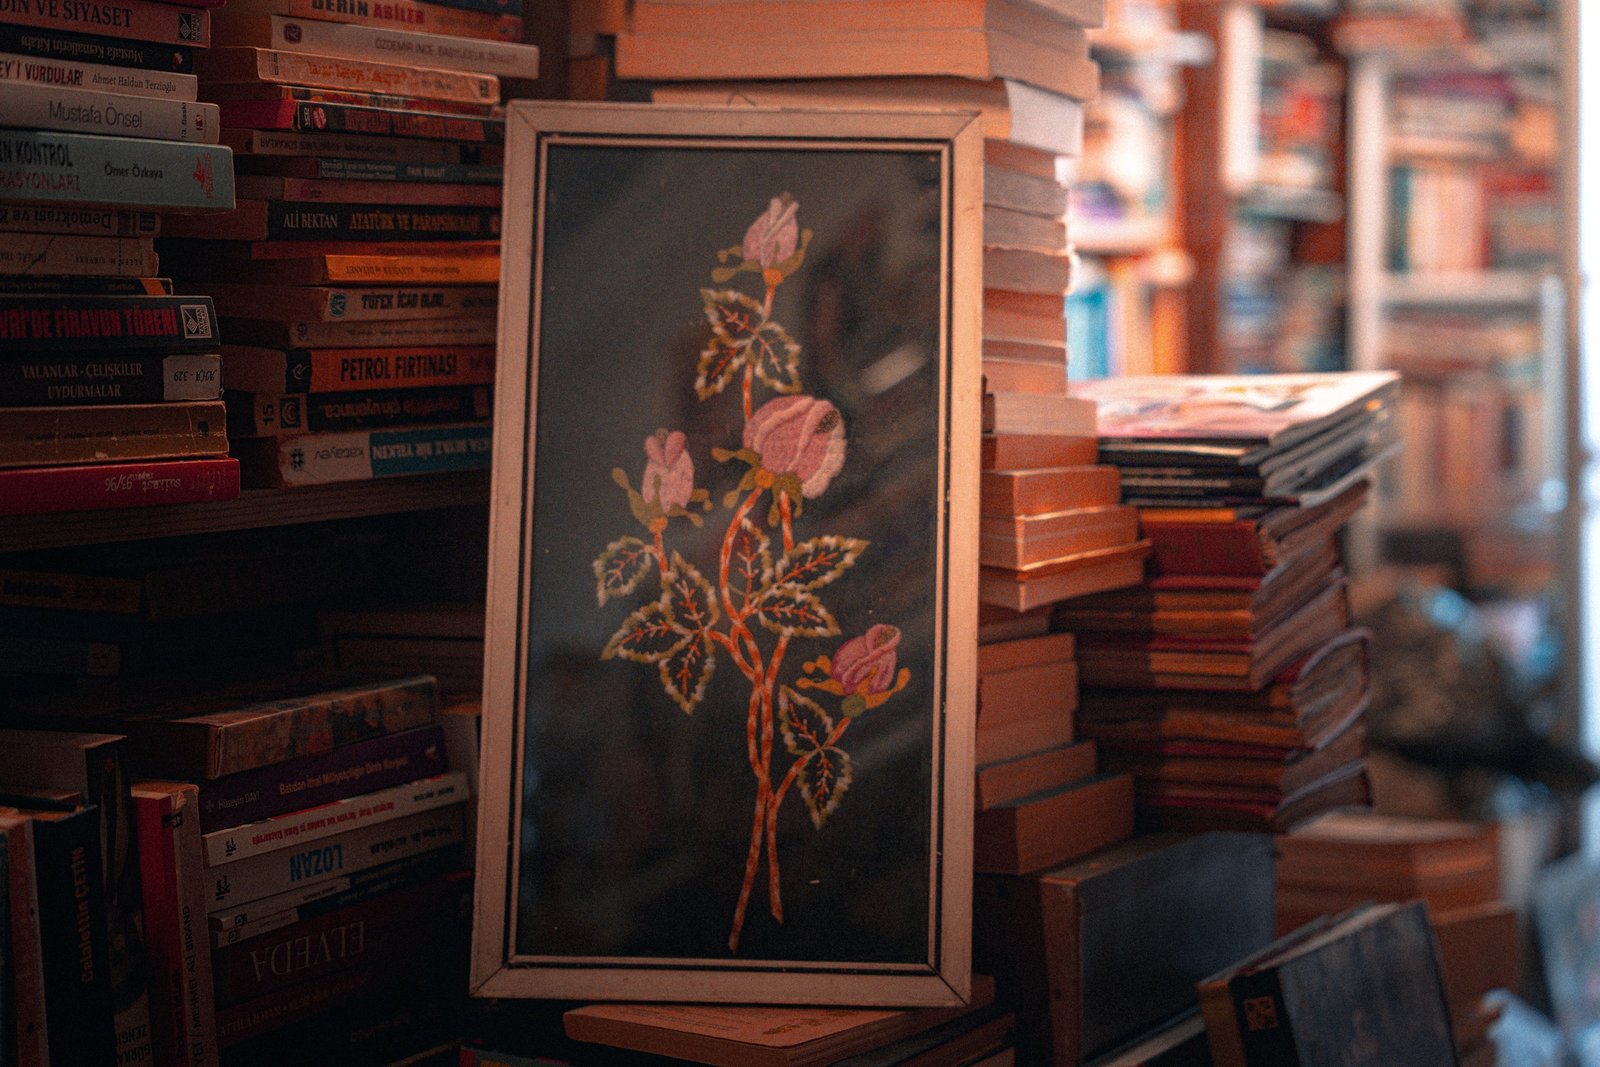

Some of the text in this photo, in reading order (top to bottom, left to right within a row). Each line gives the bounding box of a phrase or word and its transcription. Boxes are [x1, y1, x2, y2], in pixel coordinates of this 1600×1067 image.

[37, 0, 59, 18] VE
[62, 0, 133, 28] SİYASET
[373, 3, 425, 24] ABİLER
[53, 40, 105, 59] Kemallerin
[107, 47, 144, 63] Mustafa
[92, 73, 177, 94] Ahmet Haldun Terzioğlu
[48, 100, 143, 129] Mustafa Önsel
[16, 139, 73, 168] KONTROL
[104, 160, 163, 180] Ömer Özkaya
[14, 208, 30, 222] ve
[34, 210, 112, 229] Demokrasi
[284, 211, 299, 228] ALİ
[301, 213, 338, 229] BEKTAN
[350, 211, 395, 230] ATATÜRK
[55, 304, 123, 337] FİRAVUN
[124, 304, 179, 337] TÖRENİ
[21, 364, 78, 379] YALANLAR
[86, 360, 144, 380] ÇELİŞKİLER
[173, 370, 189, 382] 329
[341, 357, 391, 382] PETROL
[395, 355, 458, 379] FIRTINASI
[48, 384, 121, 399] UYDURMALAR
[262, 403, 275, 426] 15
[314, 446, 364, 461] katayev
[104, 474, 134, 493] 93/96
[289, 843, 343, 883] LOZAN
[71, 847, 95, 984] Celalettin ÇETİN
[181, 905, 195, 952] BİRAND
[250, 920, 366, 983] ELVEDA
[185, 954, 197, 975] ALİ
[188, 978, 202, 1029] MEHMET
[117, 1043, 152, 1065] GÜRKA
